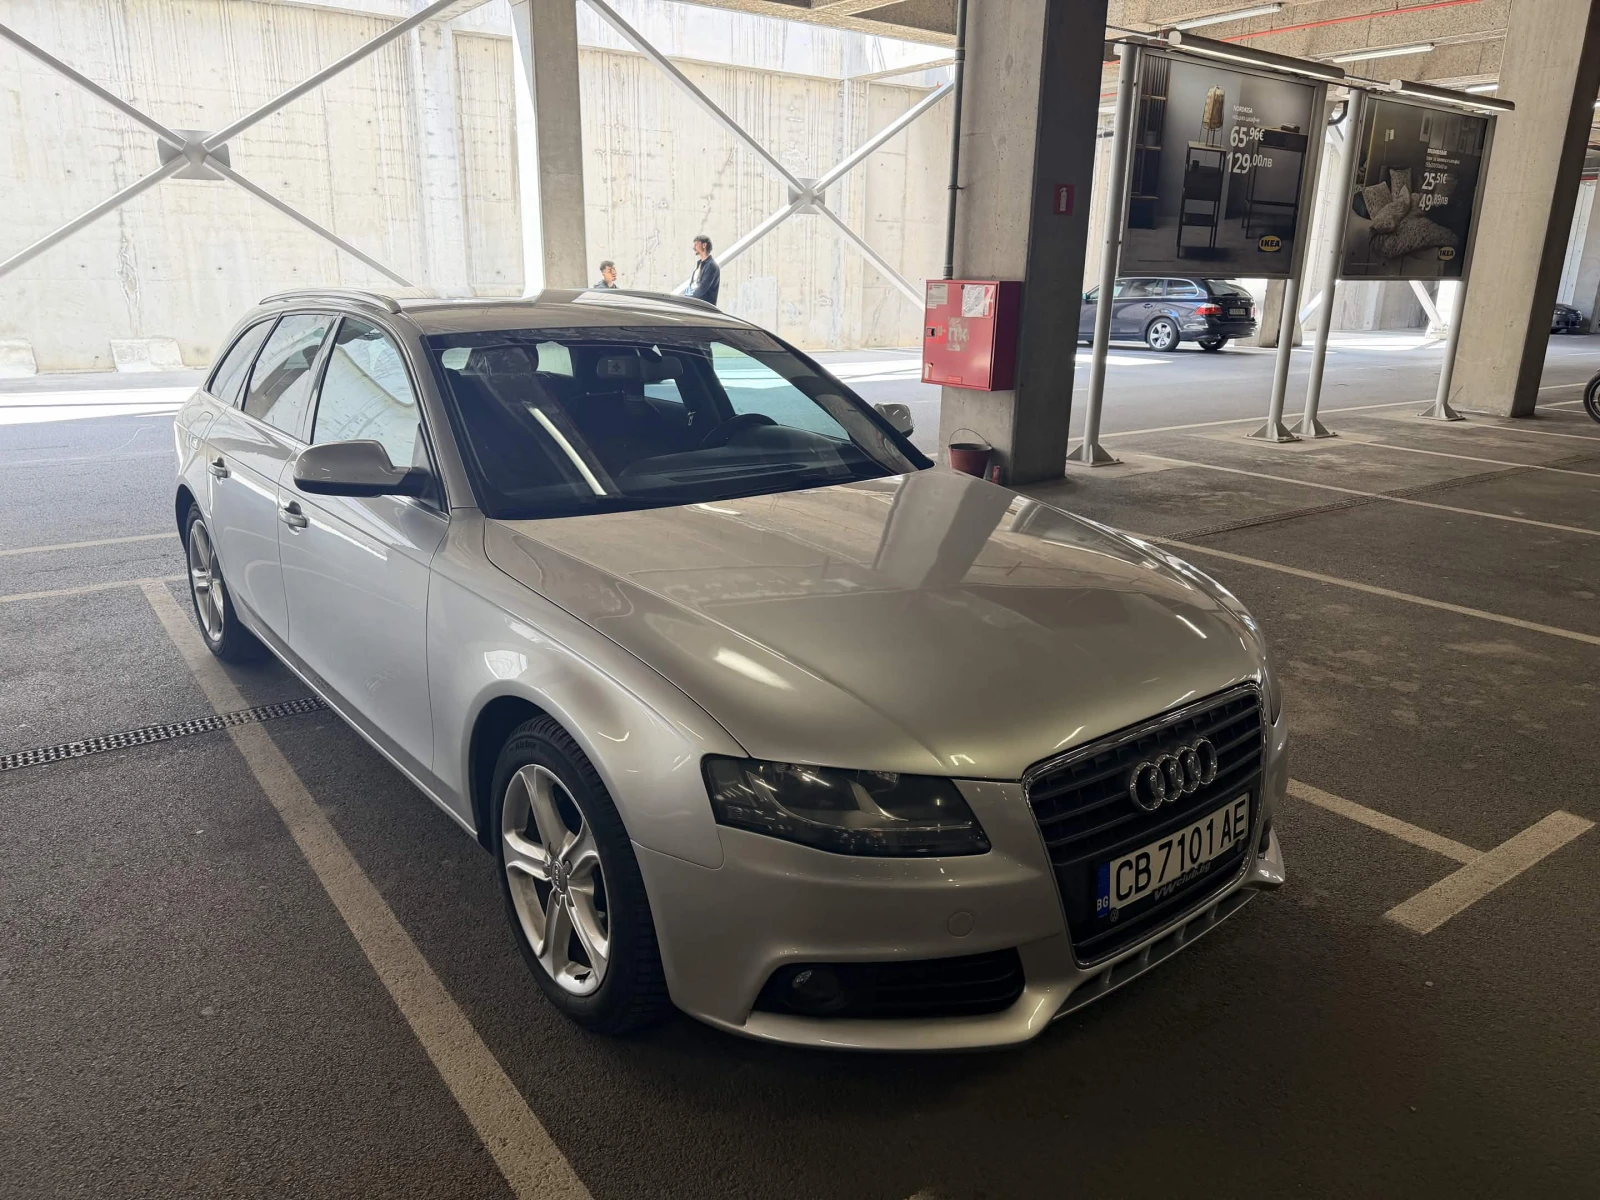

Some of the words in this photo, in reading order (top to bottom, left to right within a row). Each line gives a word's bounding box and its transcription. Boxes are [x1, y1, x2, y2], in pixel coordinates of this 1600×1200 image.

[1260, 239, 1280, 248] IKEA
[1115, 851, 1152, 902] CB
[1157, 817, 1214, 883] 7101
[1220, 799, 1246, 849] AE
[1096, 896, 1109, 911] BG
